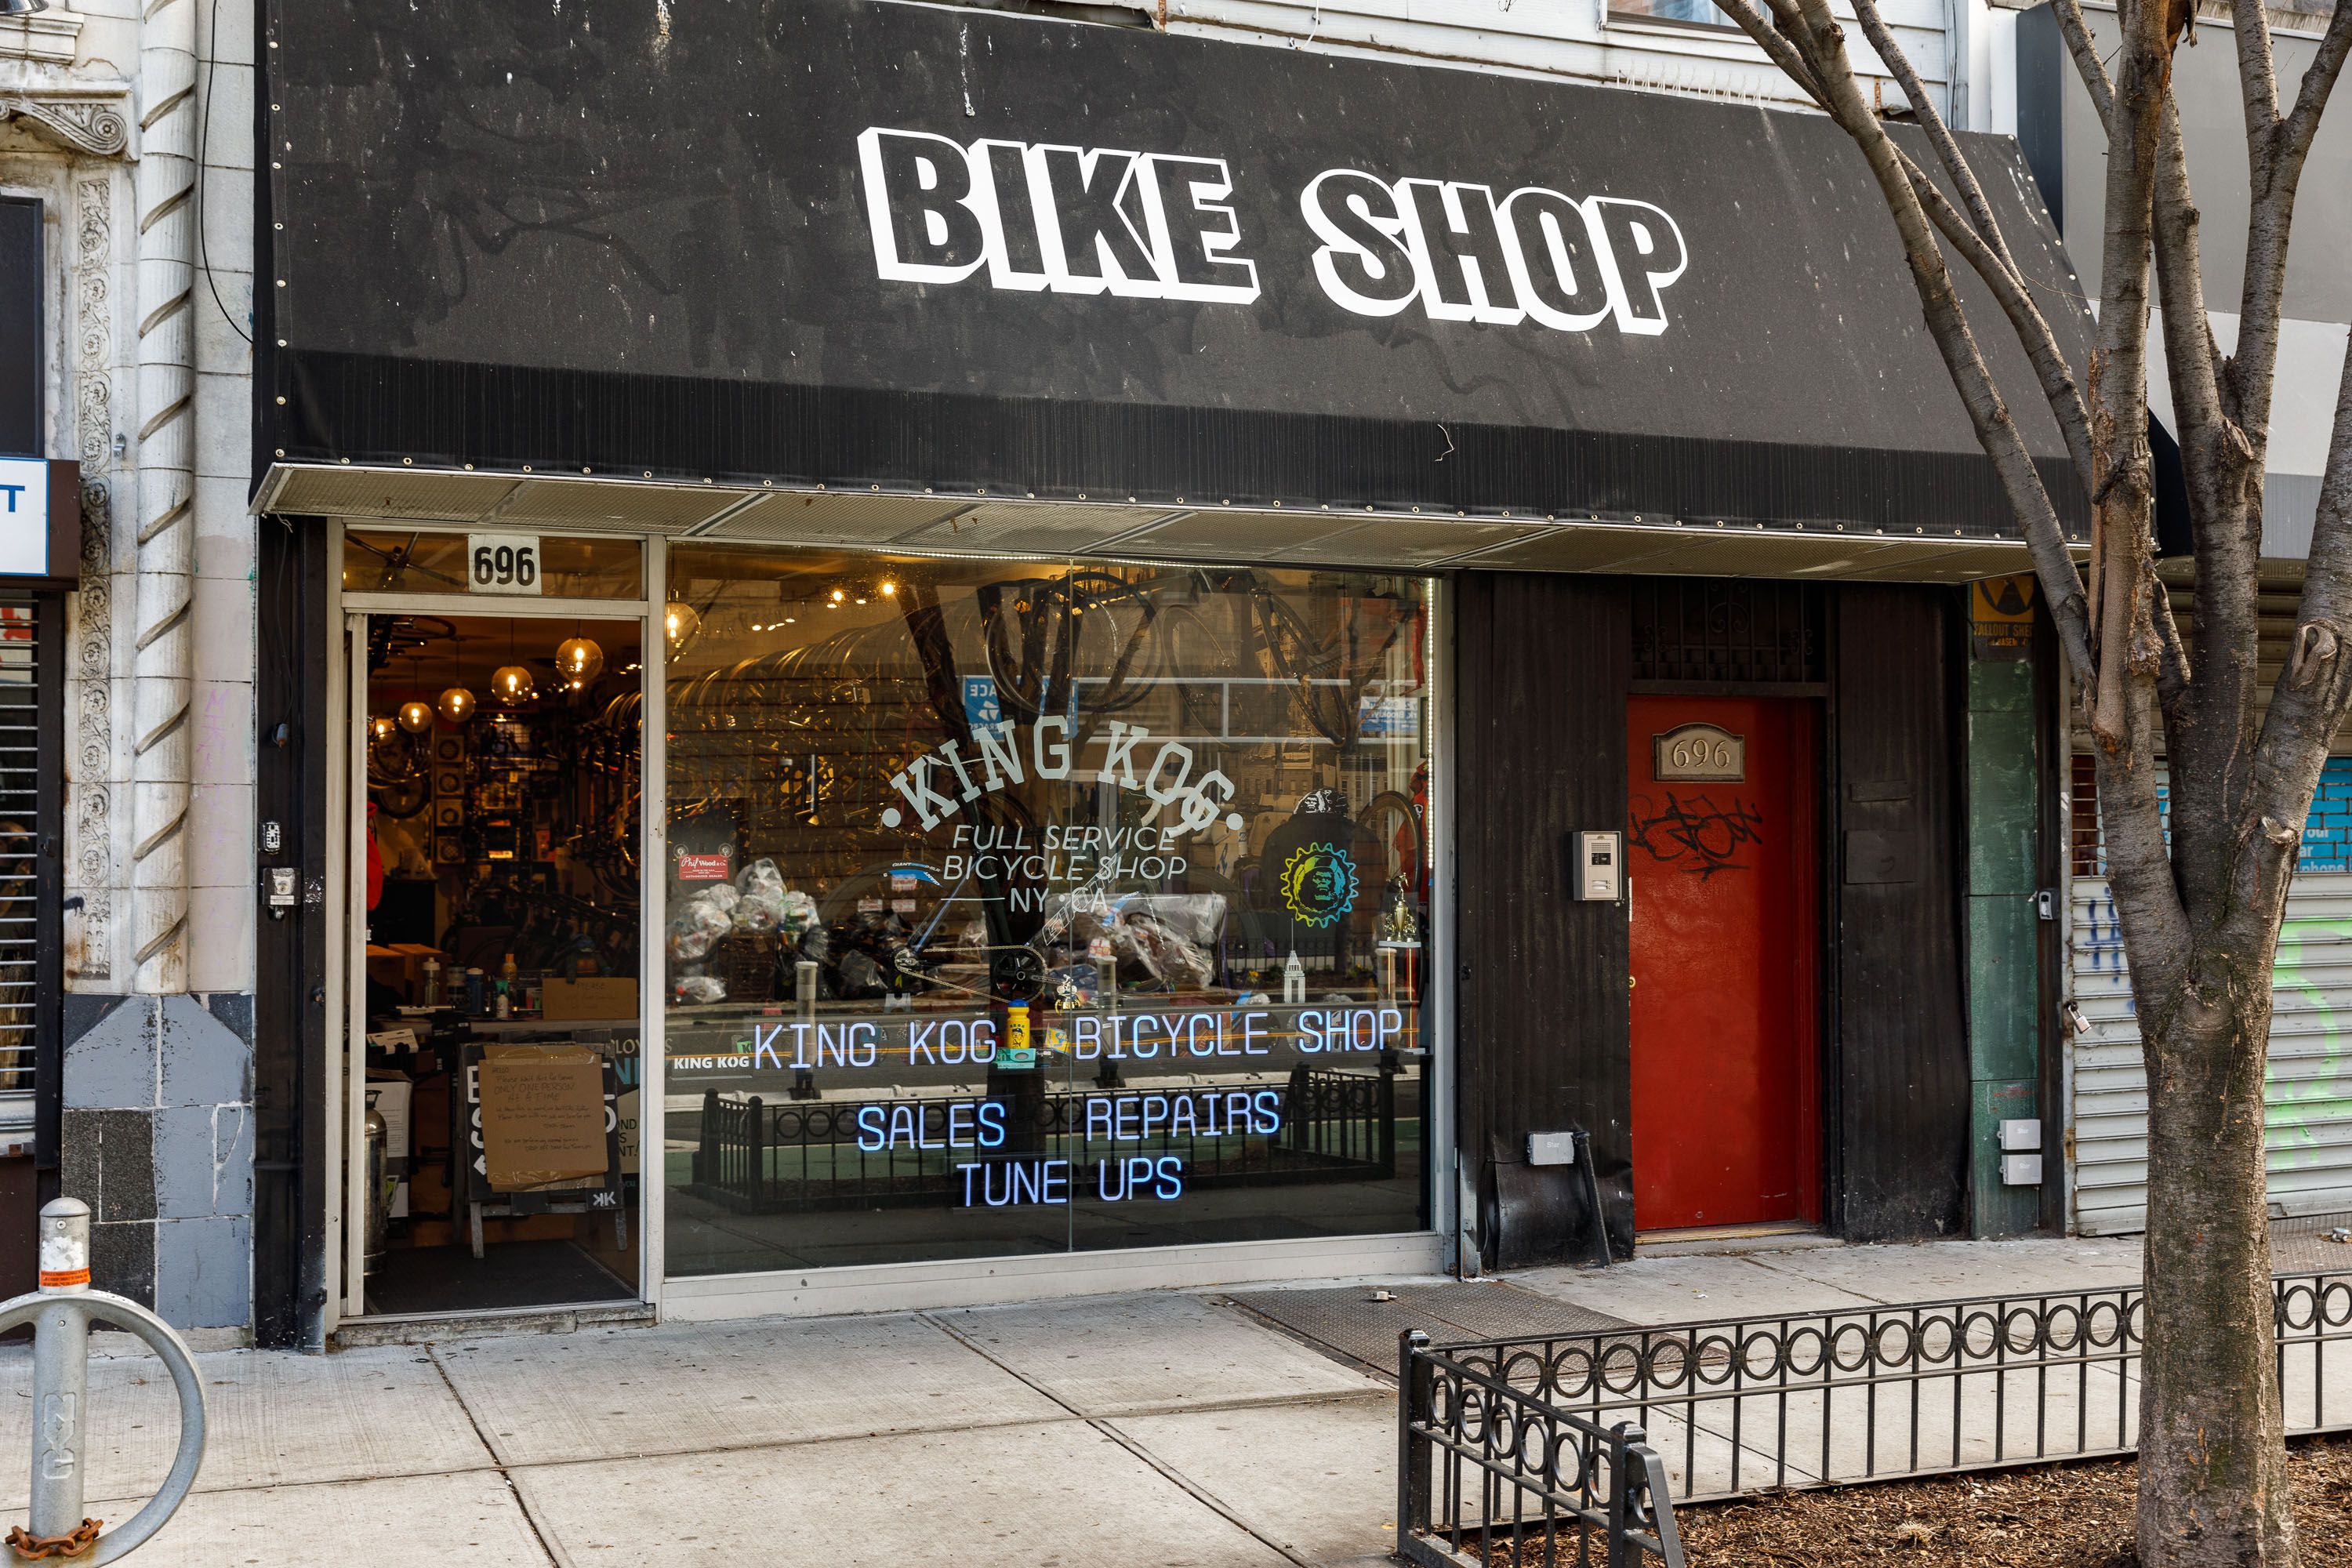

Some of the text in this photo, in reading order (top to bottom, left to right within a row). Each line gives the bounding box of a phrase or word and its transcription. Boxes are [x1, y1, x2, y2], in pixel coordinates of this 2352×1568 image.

[857, 126, 1688, 336] BIKE SHOP
[474, 546, 535, 586] 696
[1671, 739, 1731, 769] 696
[891, 715, 1234, 831] KING KOG
[953, 825, 1177, 851] FULL SERVICE
[943, 855, 1187, 880] BICYCLE SHOP
[1010, 887, 1108, 913] NY CA
[755, 1008, 1403, 1070] KING KOG BICYCLE SHOP
[673, 1056, 750, 1070] KING KOG
[494, 1082, 575, 1095] ONLY ONE PERSON
[858, 1091, 1280, 1152] SALES REPAIRS
[956, 1156, 1182, 1207] TUNE UPS
